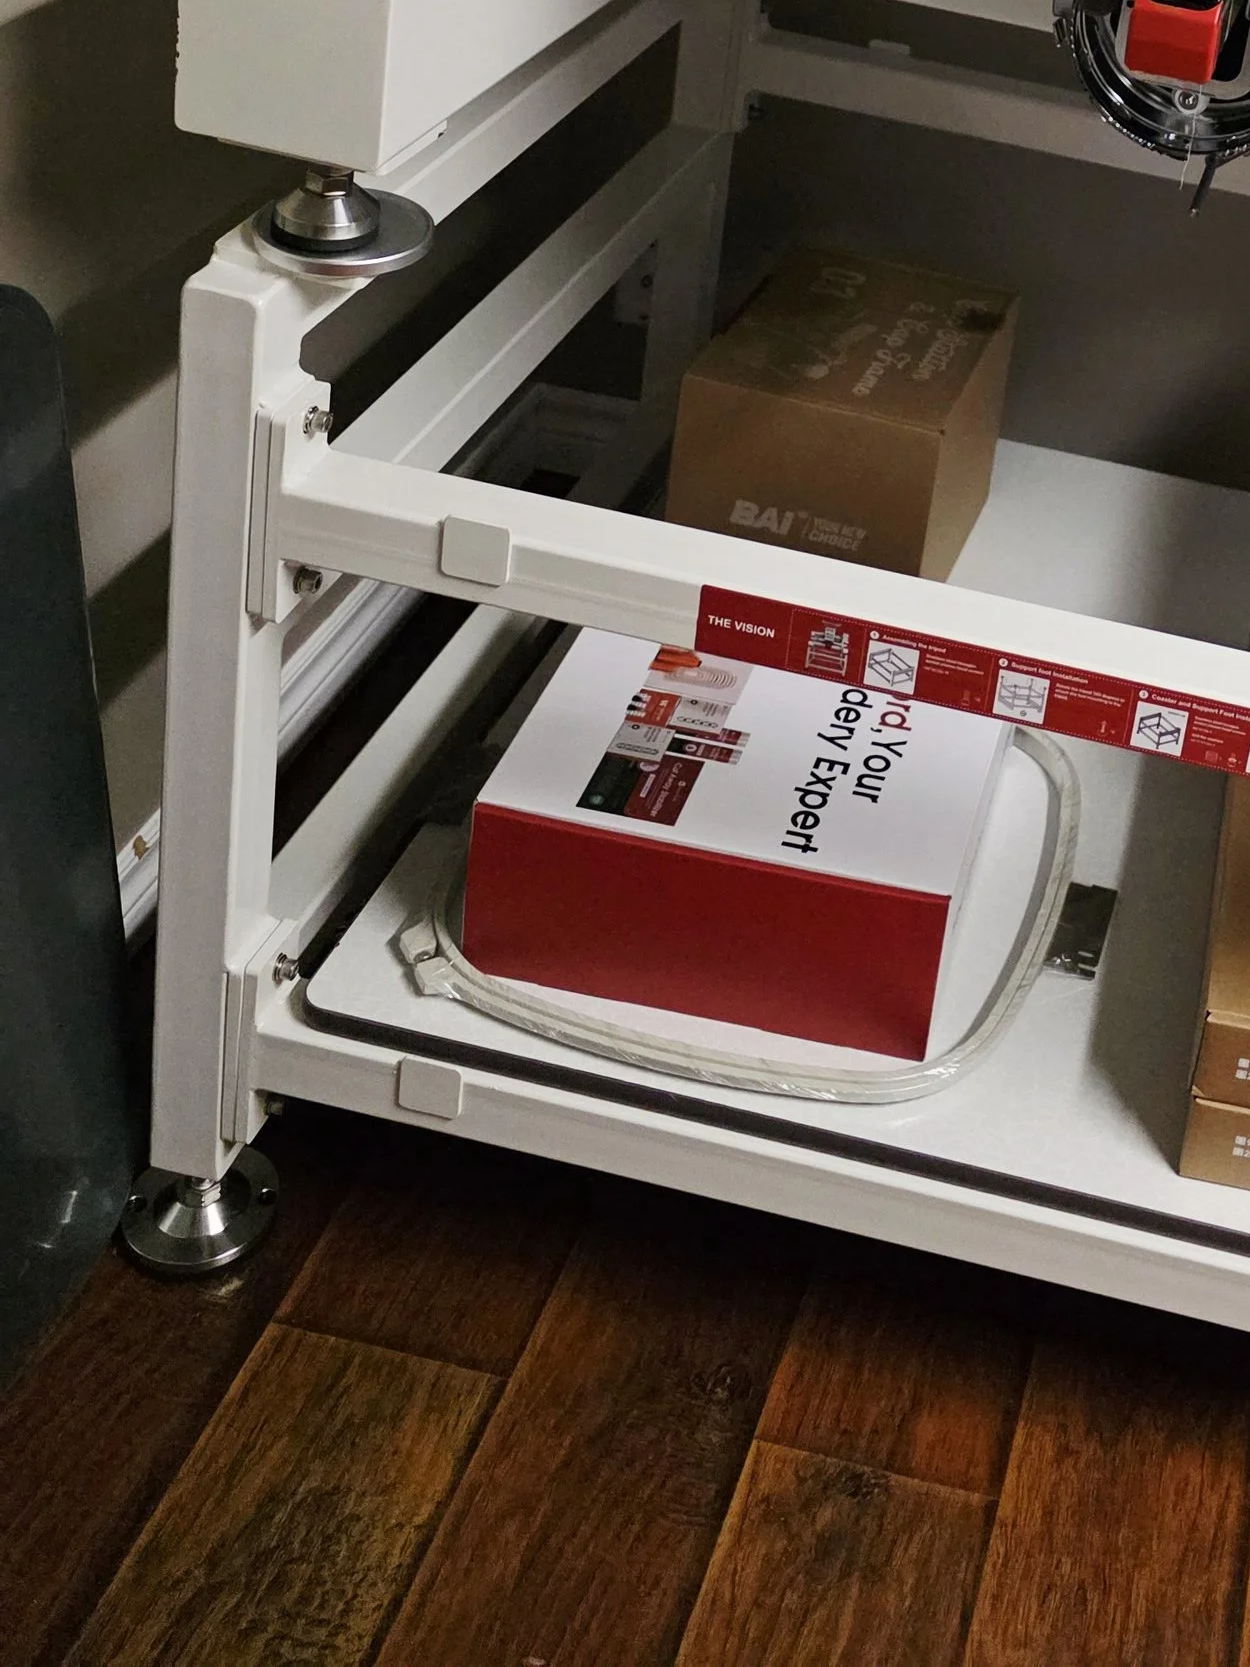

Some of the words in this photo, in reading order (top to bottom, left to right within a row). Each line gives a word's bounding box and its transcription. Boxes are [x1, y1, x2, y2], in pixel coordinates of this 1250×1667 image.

[708, 614, 732, 629] THE
[734, 620, 776, 639] VISION
[918, 642, 928, 651] the
[929, 644, 947, 654] tripod
[1011, 661, 1037, 674] Support
[1053, 670, 1089, 685] Installation
[1151, 692, 1177, 705] Coaster
[1179, 699, 1191, 708] and
[1192, 702, 1218, 716] Support
[1219, 708, 1235, 718] Foot
[852, 740, 908, 804] Your
[781, 757, 851, 854] Expert
